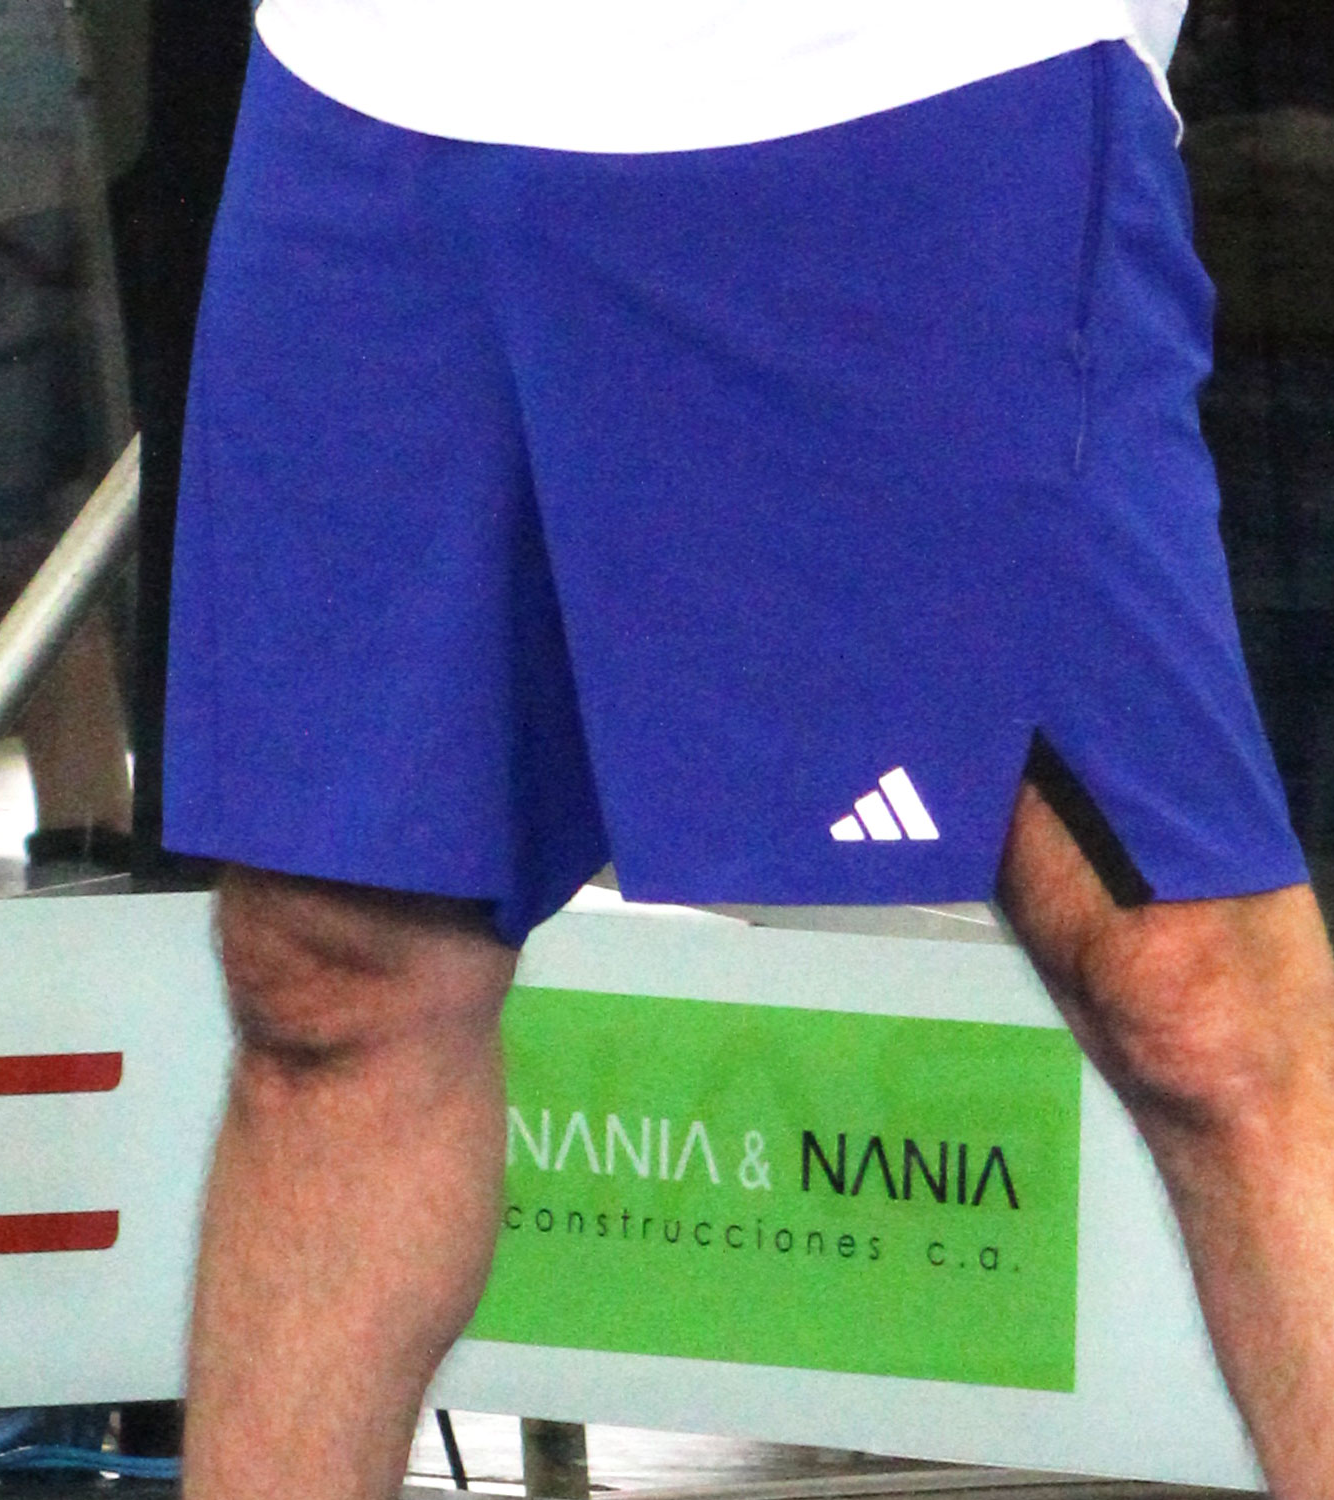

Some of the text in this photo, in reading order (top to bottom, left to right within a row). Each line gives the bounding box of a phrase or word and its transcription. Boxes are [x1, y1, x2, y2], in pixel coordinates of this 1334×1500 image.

[505, 1105, 1020, 1210] NANIA & NANIA
[504, 1205, 1020, 1272] construcciones c.a.
